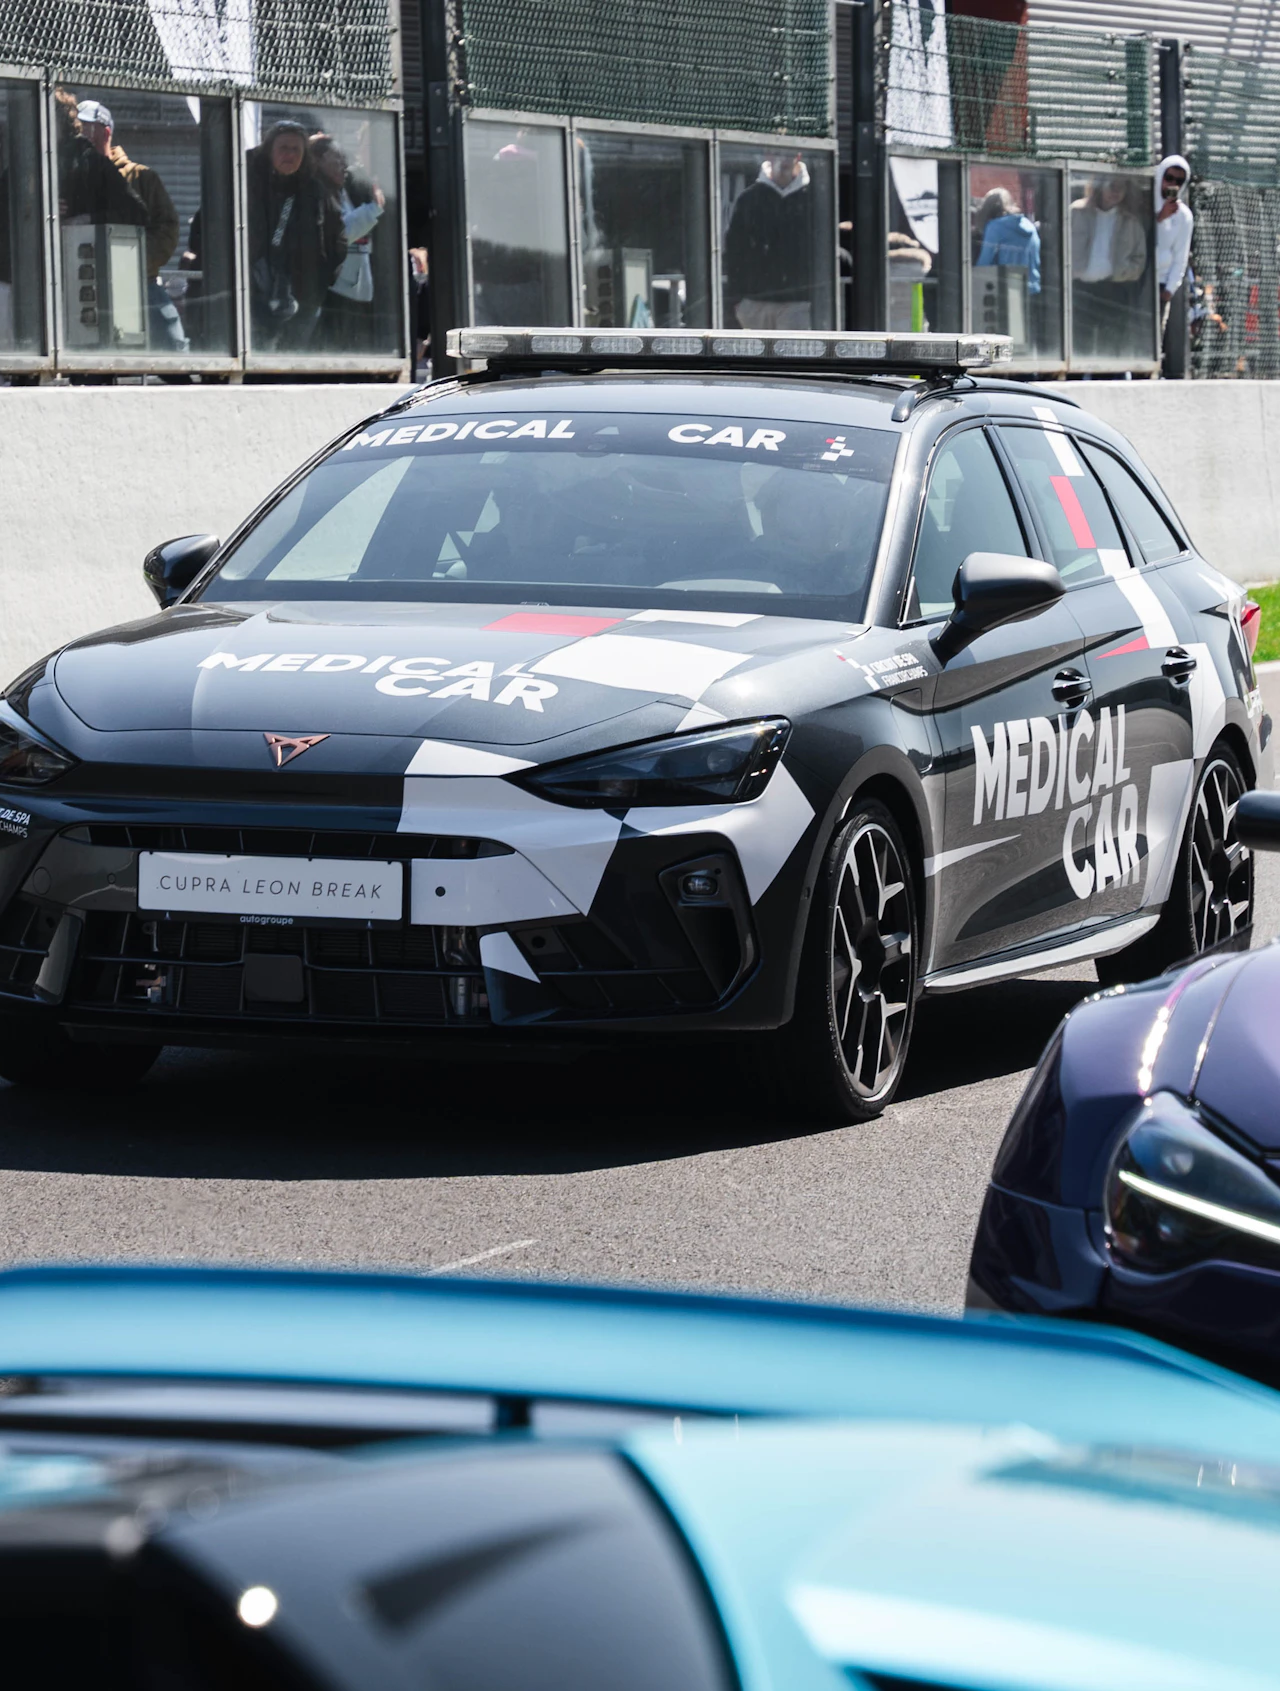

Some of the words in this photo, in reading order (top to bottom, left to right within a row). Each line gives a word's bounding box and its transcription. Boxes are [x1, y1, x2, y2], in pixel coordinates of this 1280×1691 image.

[345, 418, 576, 451] MEDICAL
[668, 423, 787, 451] CAR
[196, 651, 538, 679] MEDICAL
[375, 673, 559, 713] CAR
[970, 704, 1132, 826] MEDICAL
[1, 808, 16, 821] DE
[13, 811, 31, 826] SPA
[1062, 783, 1141, 900] CAR
[159, 875, 231, 893] CUPRA
[242, 878, 301, 896] LEON
[311, 881, 382, 899] BREAK
[239, 914, 294, 926] autogroupe
